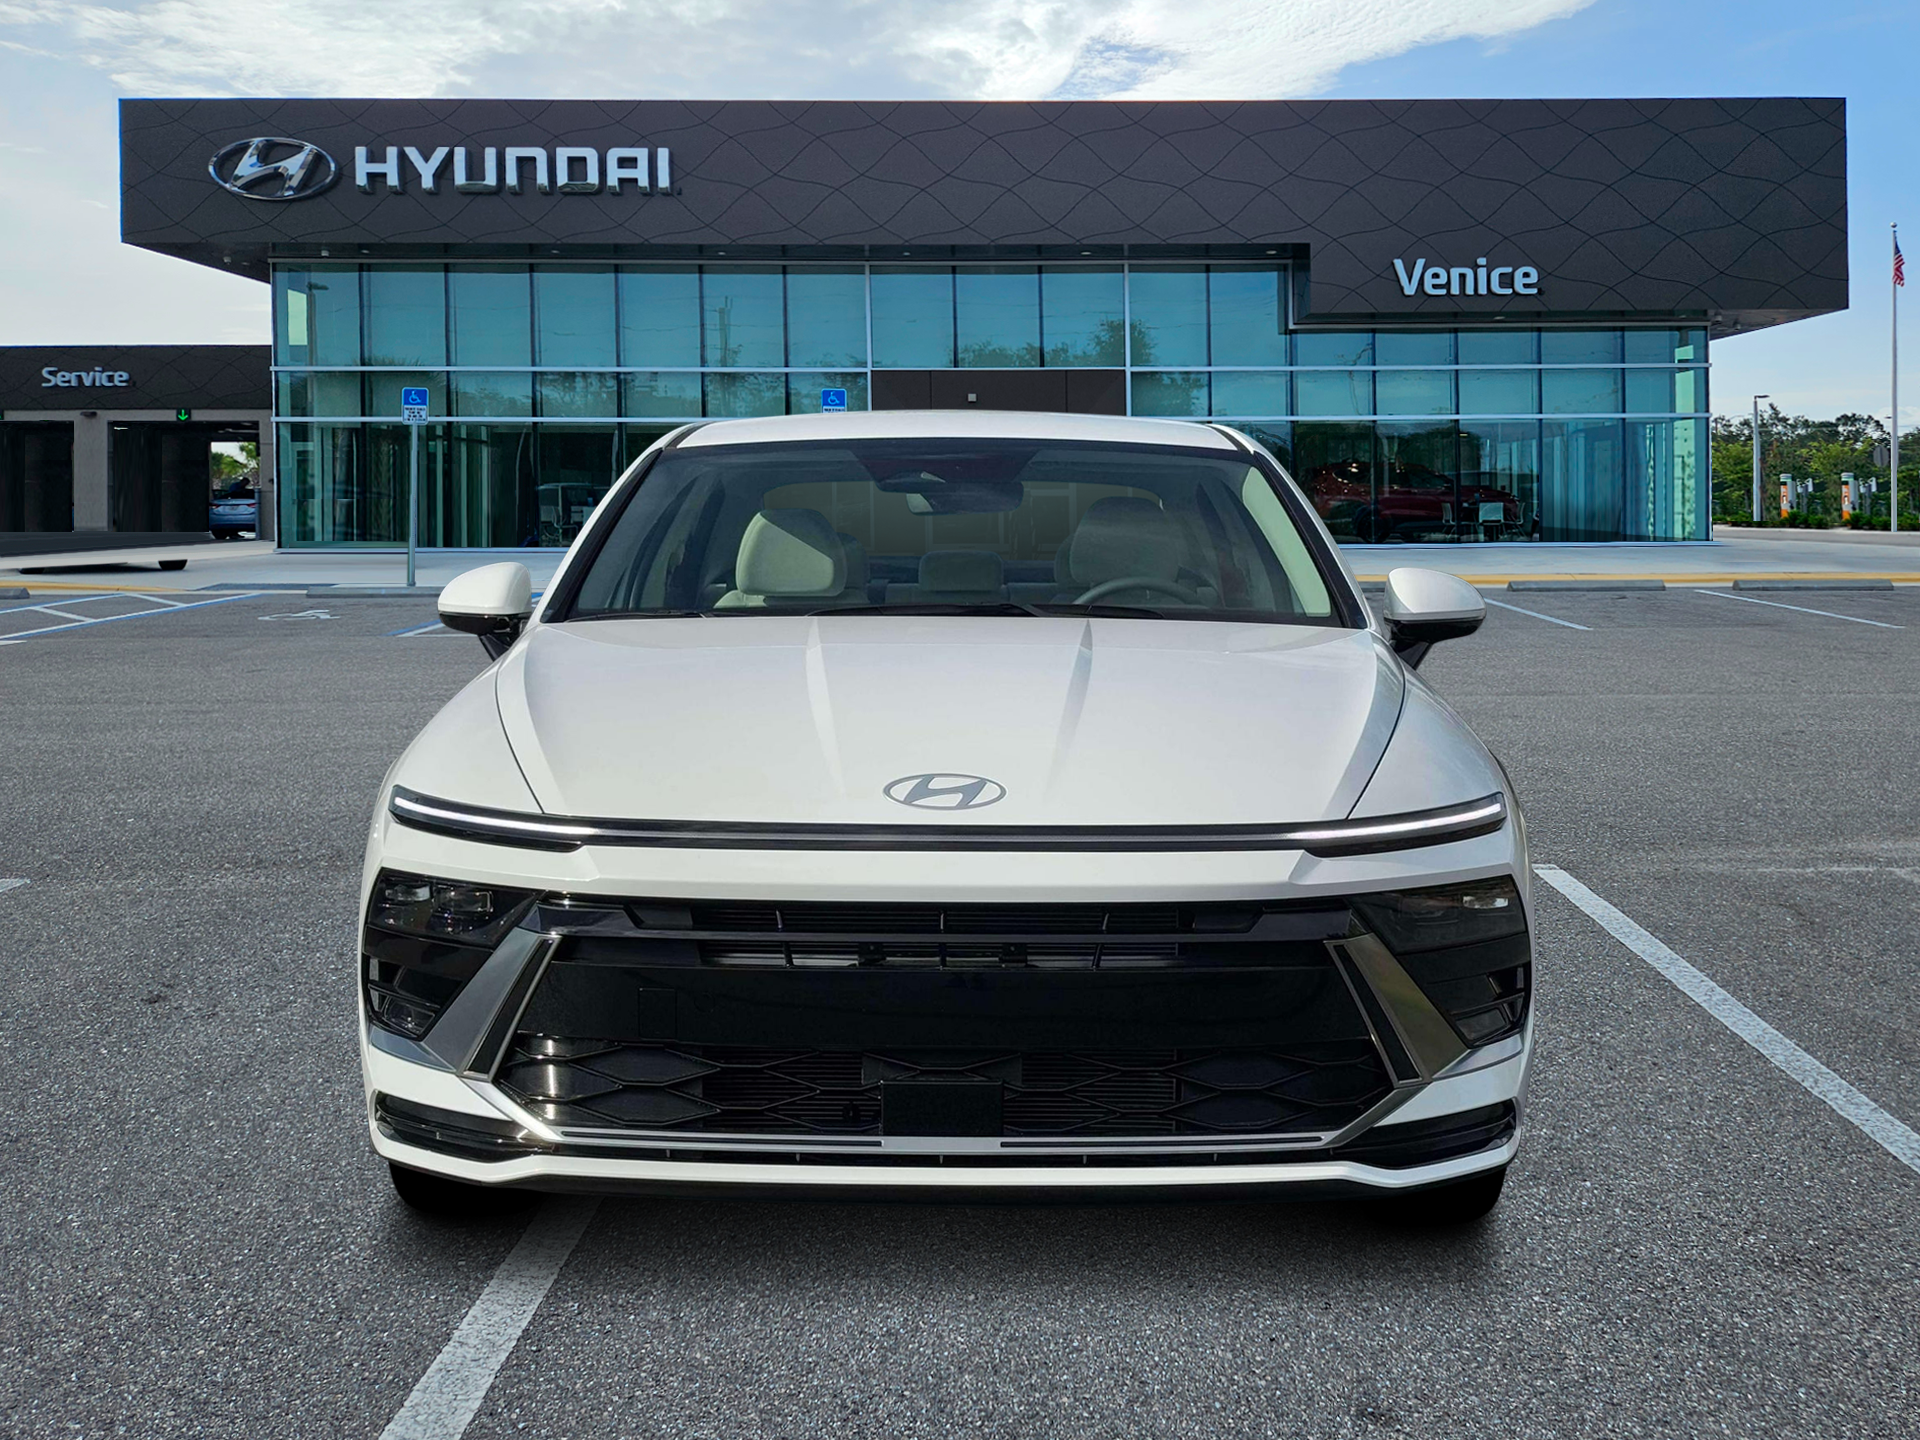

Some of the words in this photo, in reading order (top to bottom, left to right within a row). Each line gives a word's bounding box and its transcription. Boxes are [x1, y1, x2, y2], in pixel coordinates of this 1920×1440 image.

[354, 146, 671, 194] HYUNDAI
[1393, 257, 1539, 296] Venice
[41, 366, 130, 387] Service
